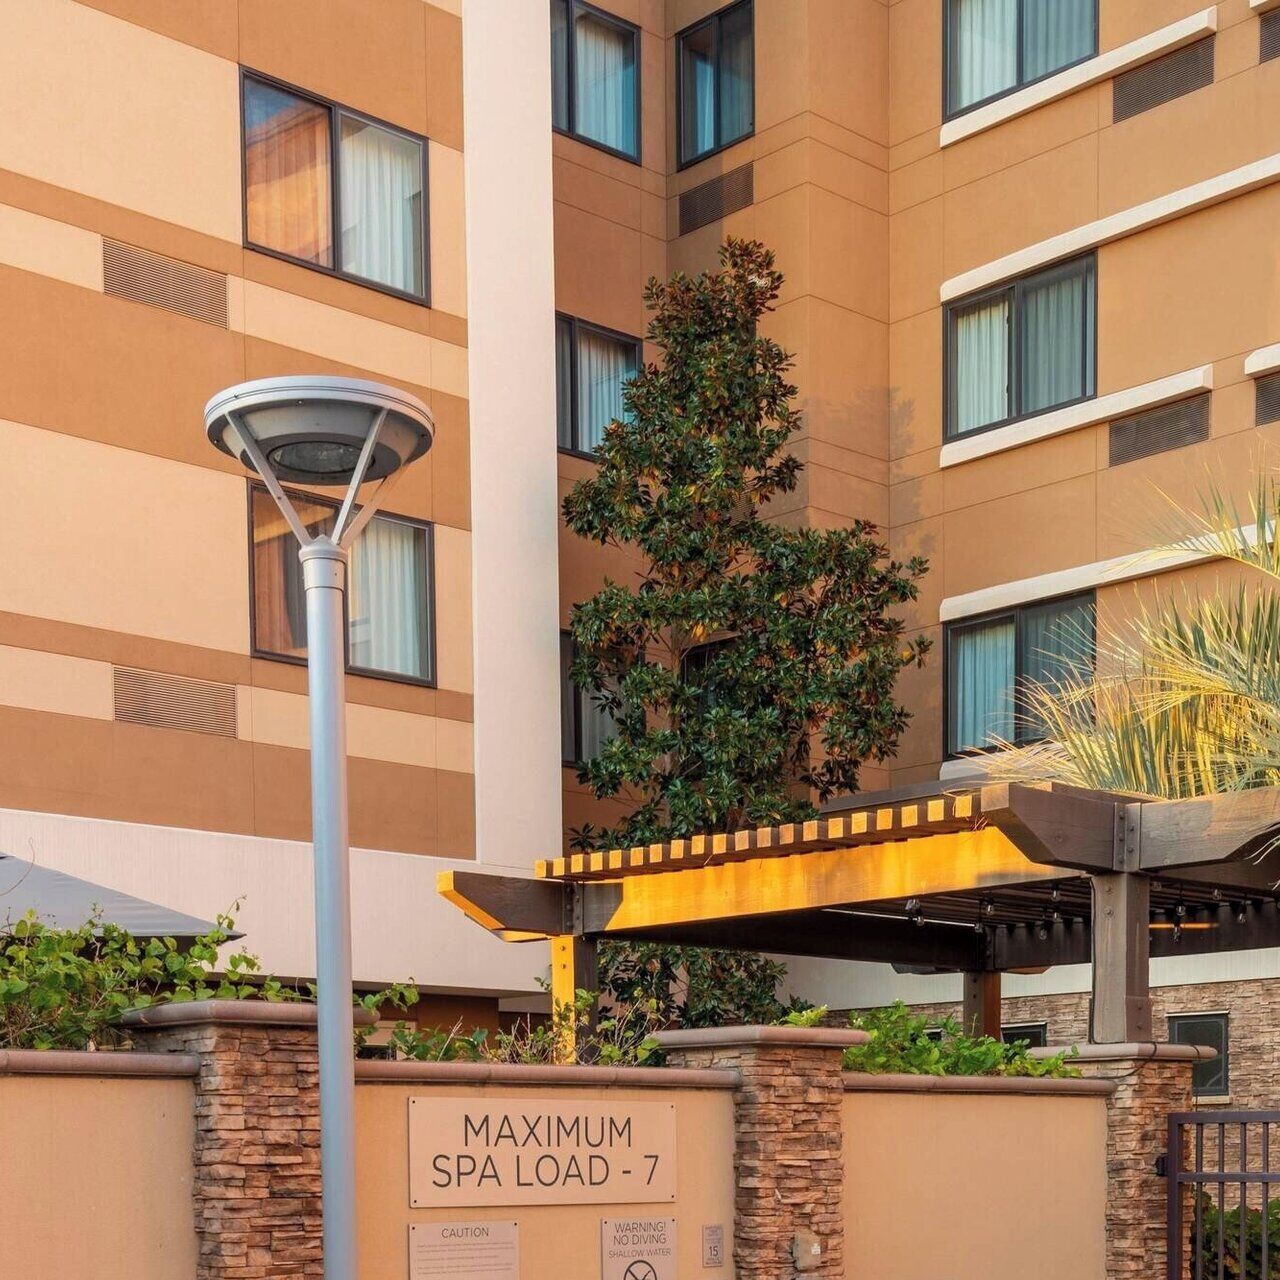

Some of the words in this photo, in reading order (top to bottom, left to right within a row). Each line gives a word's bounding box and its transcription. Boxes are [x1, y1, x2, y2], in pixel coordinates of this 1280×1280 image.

[464, 1114, 632, 1148] MAXIMUM
[432, 1154, 502, 1188] SPA
[516, 1154, 610, 1187] LOAD
[643, 1154, 660, 1186] 7
[441, 1227, 489, 1239] CAUTION
[614, 1221, 667, 1233] WARNING!
[613, 1234, 629, 1246] NO
[631, 1233, 667, 1245] DIVING
[608, 1248, 644, 1259] SHALLOW
[646, 1247, 672, 1257] WATER
[709, 1245, 719, 1257] 15
